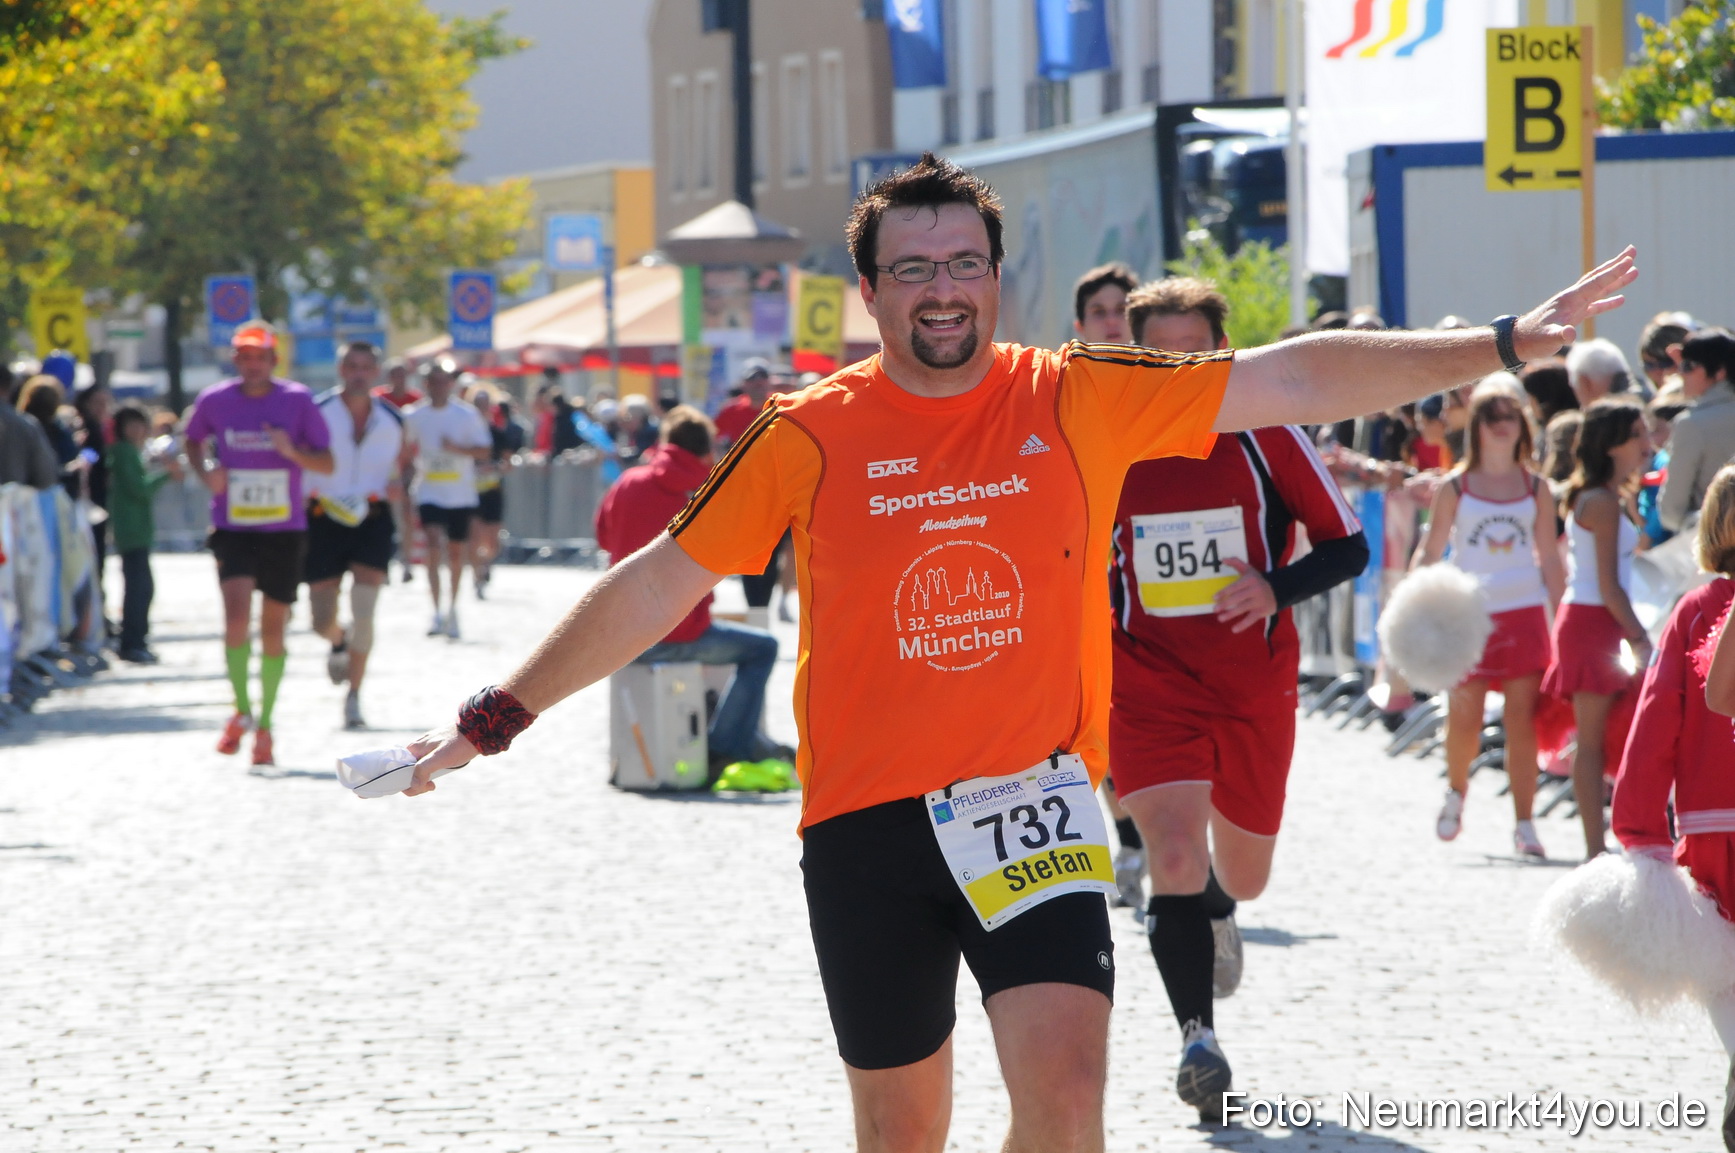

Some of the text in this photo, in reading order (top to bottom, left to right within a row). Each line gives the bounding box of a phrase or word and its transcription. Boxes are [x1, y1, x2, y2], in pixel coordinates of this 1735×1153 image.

[1498, 33, 1581, 61] Block
[1515, 77, 1565, 153] B
[47, 312, 73, 349] C
[808, 300, 833, 336] C
[1019, 445, 1050, 456] adidas
[867, 458, 919, 479] DAK
[869, 474, 1030, 516] SportScheck
[919, 514, 987, 533] Abendzeitung
[924, 544, 943, 556] Leipzig
[976, 541, 1000, 554] Hamburg
[1155, 538, 1222, 578] 954
[994, 591, 1010, 600] 2010
[908, 603, 1011, 631] 32. Stadtlauf
[898, 626, 1022, 660] München
[952, 781, 1023, 810] PFLEIDERER
[957, 792, 1026, 819] AKTIENGESELLSCHAFT
[972, 796, 1083, 863] 732
[1002, 851, 1093, 892] Stefan
